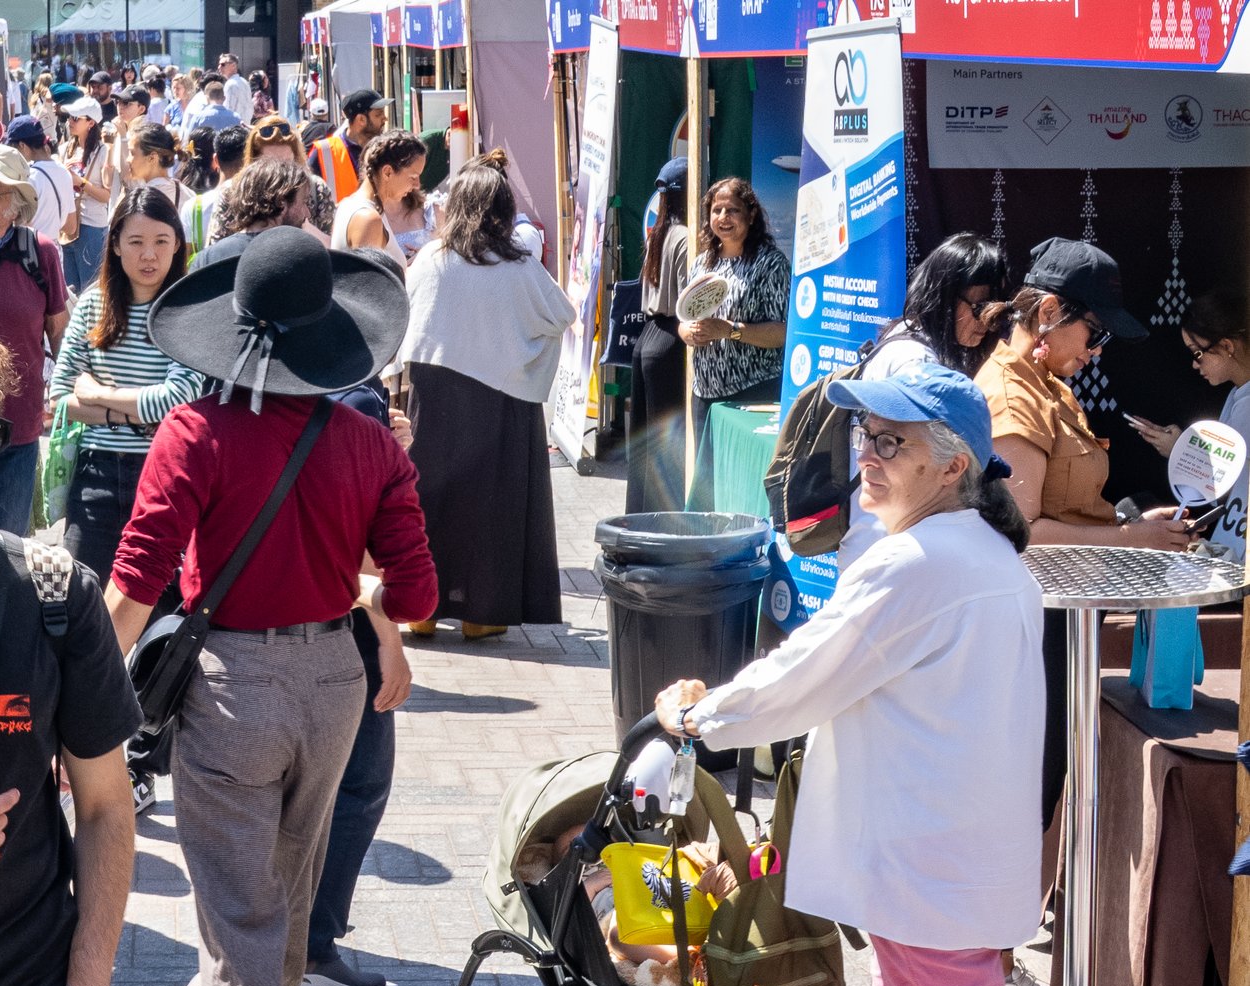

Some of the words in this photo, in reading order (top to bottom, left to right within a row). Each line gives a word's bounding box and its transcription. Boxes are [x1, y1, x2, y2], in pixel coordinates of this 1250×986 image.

[953, 69, 978, 79] Main
[980, 69, 1023, 79] Partners
[1088, 113, 1148, 124] THAILAND
[1104, 106, 1132, 117] amazing
[835, 115, 867, 130] ABPLUS
[849, 177, 874, 201] DIGITAL
[872, 160, 896, 188] BANKING
[823, 274, 846, 290] INSTANT
[845, 278, 877, 293] ACCOUNT
[857, 295, 879, 309] CHECKS
[818, 344, 835, 359] GBP
[817, 360, 832, 371] AND
[1188, 435, 1213, 453] EVA
[1212, 447, 1236, 462] AIR
[797, 592, 822, 610] CASH
